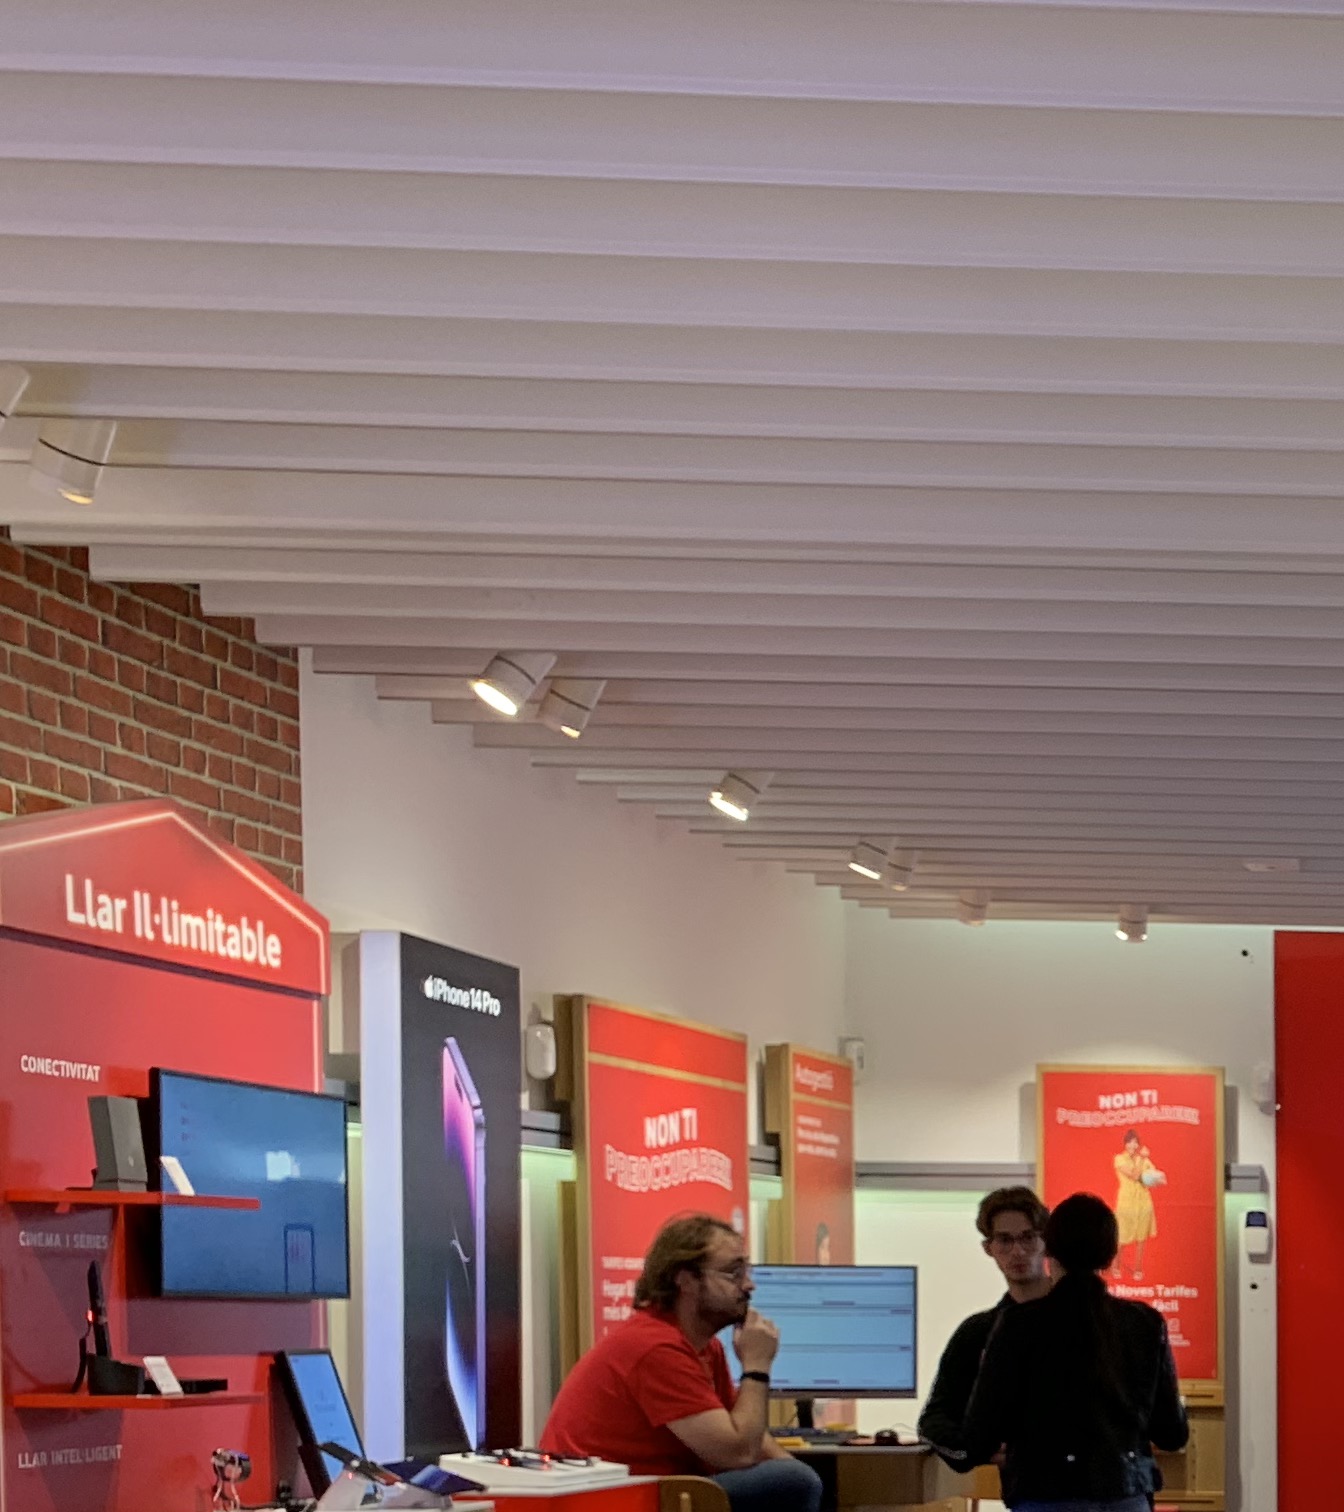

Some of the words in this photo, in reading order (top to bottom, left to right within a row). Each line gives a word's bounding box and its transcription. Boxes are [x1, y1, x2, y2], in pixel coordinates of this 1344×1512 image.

[65, 873, 127, 934] Llar
[433, 977, 470, 1009] iPhone
[470, 987, 482, 1012] 14
[482, 991, 501, 1016] Pro
[20, 1055, 101, 1082] CONECTIVITAT
[1099, 1092, 1138, 1110] NON
[1140, 1089, 1158, 1105] TI
[644, 1112, 680, 1149] NON
[682, 1108, 698, 1141] TI
[18, 1231, 61, 1247] CINEMA
[18, 1452, 47, 1469] LLAR
